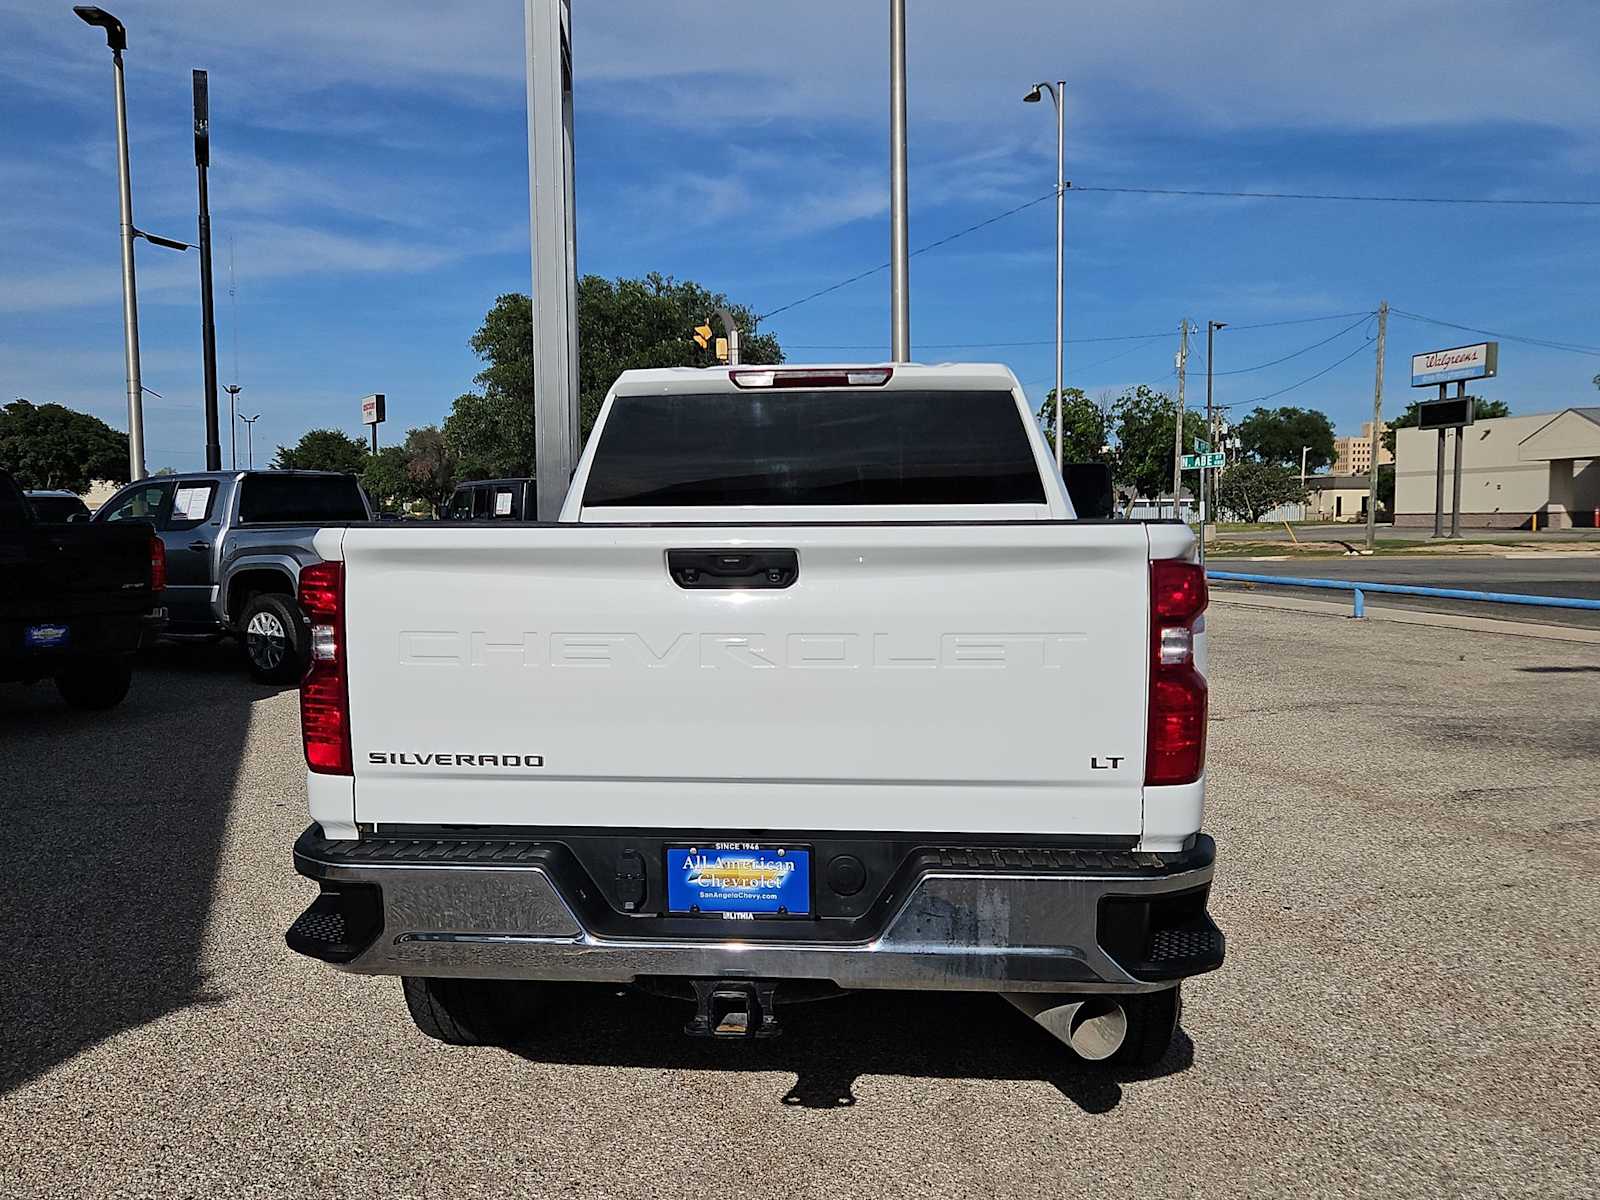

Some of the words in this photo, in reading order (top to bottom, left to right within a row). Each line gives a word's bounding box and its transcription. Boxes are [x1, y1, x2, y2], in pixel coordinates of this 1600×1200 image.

[1426, 351, 1478, 369] Walgreens
[398, 631, 1088, 671] CHEVROLET
[369, 752, 544, 767] SILVERADO
[1091, 757, 1125, 769] LT
[742, 843, 760, 851] 1946
[682, 855, 707, 870] All
[714, 856, 796, 872] American
[696, 874, 783, 889] Chevrolet
[699, 891, 778, 900] SanAngeloChevy.com
